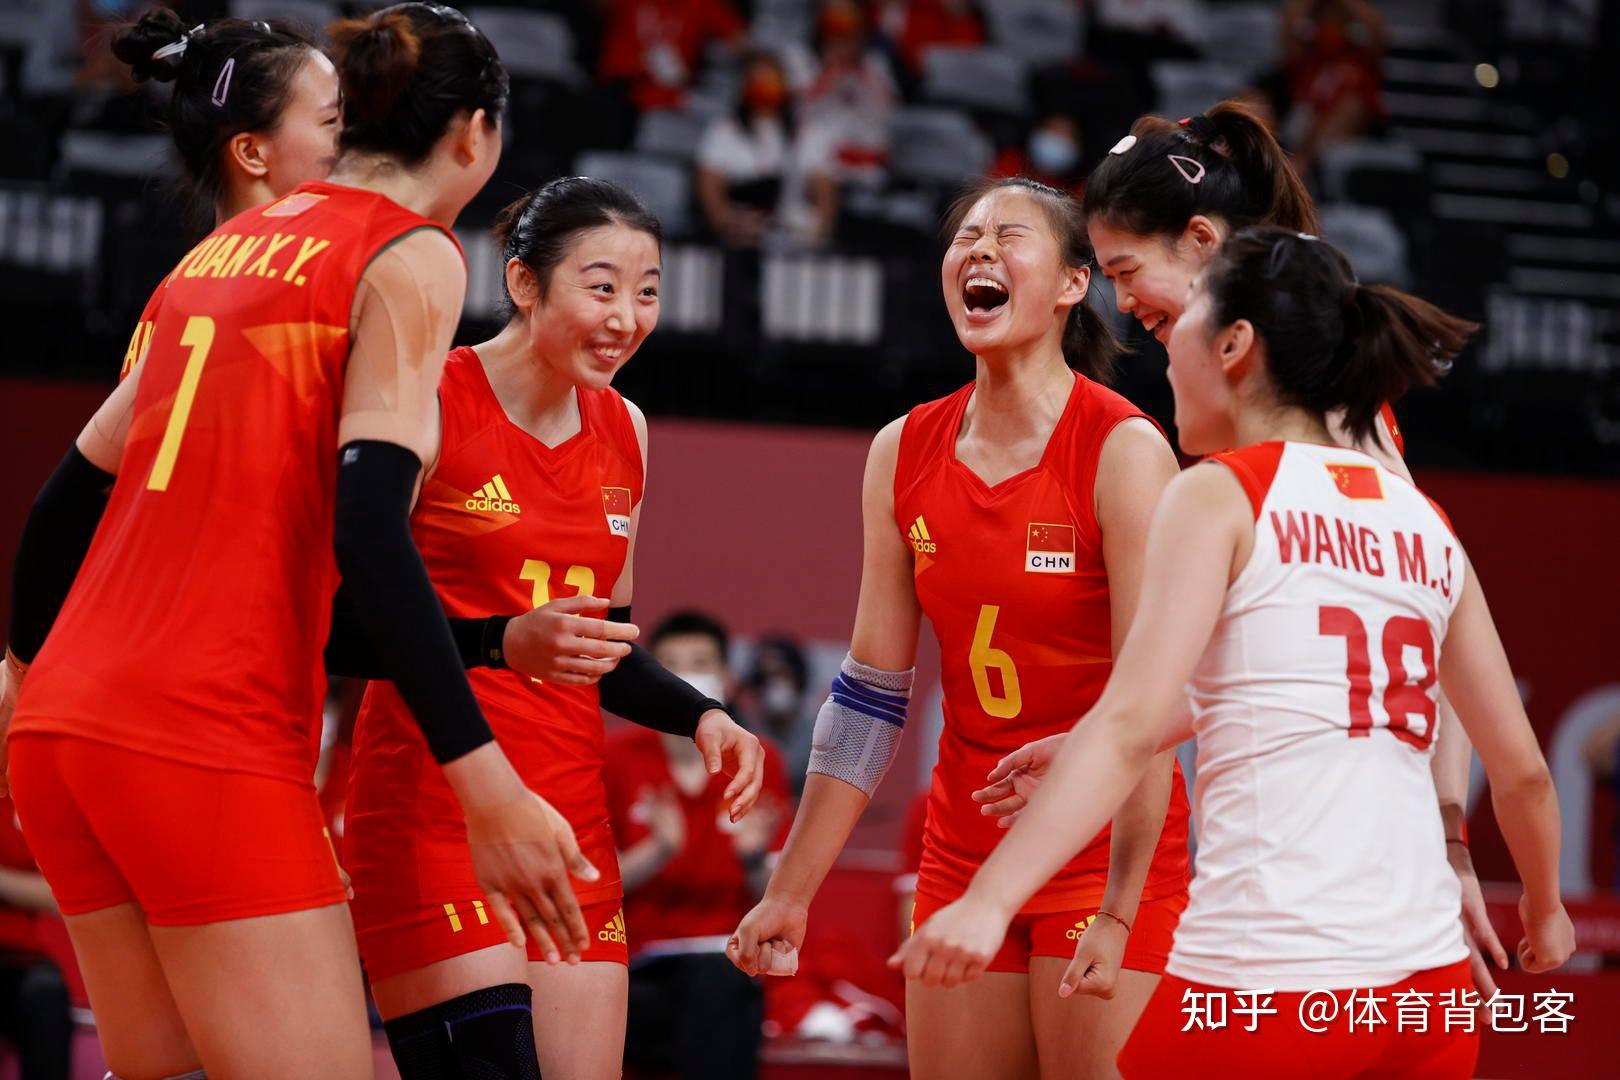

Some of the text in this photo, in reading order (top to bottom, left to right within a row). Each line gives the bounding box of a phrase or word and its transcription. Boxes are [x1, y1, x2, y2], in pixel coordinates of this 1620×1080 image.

[146, 315, 216, 492] 1
[465, 497, 521, 514] adidas
[1269, 509, 1385, 578] WANG
[1031, 555, 1070, 569] CHN
[968, 603, 1023, 719] 6
[1318, 604, 1440, 751] 18
